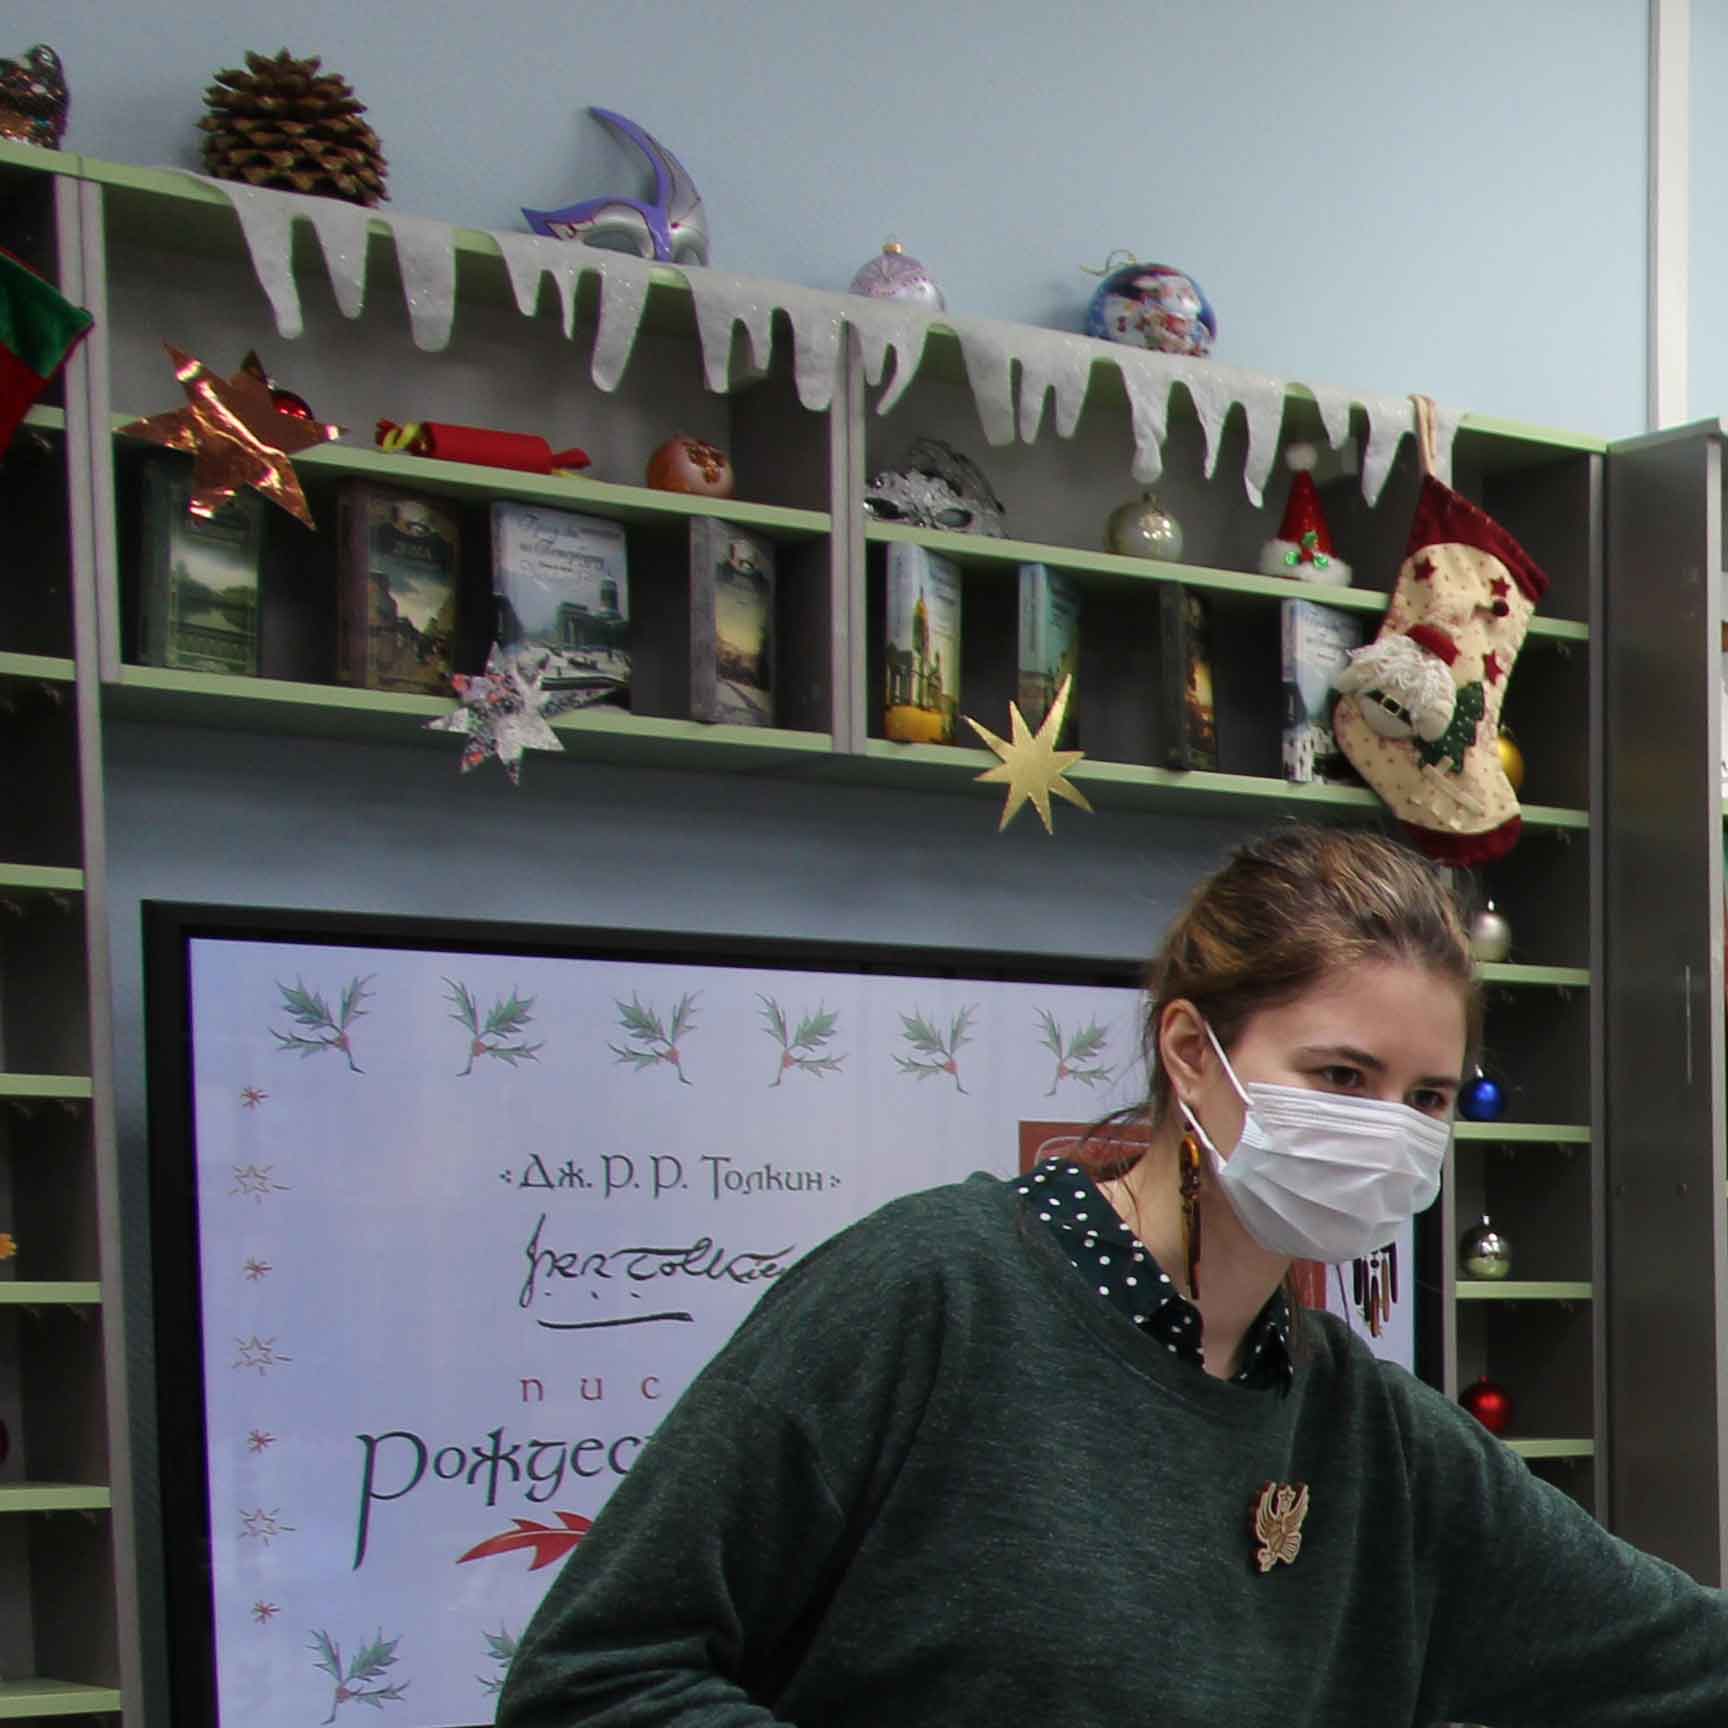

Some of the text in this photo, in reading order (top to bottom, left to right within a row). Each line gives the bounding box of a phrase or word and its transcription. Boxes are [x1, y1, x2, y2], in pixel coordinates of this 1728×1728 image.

[518, 1152, 824, 1200] Дж. Р. Р. Толкин
[352, 1426, 652, 1571] Рождес
